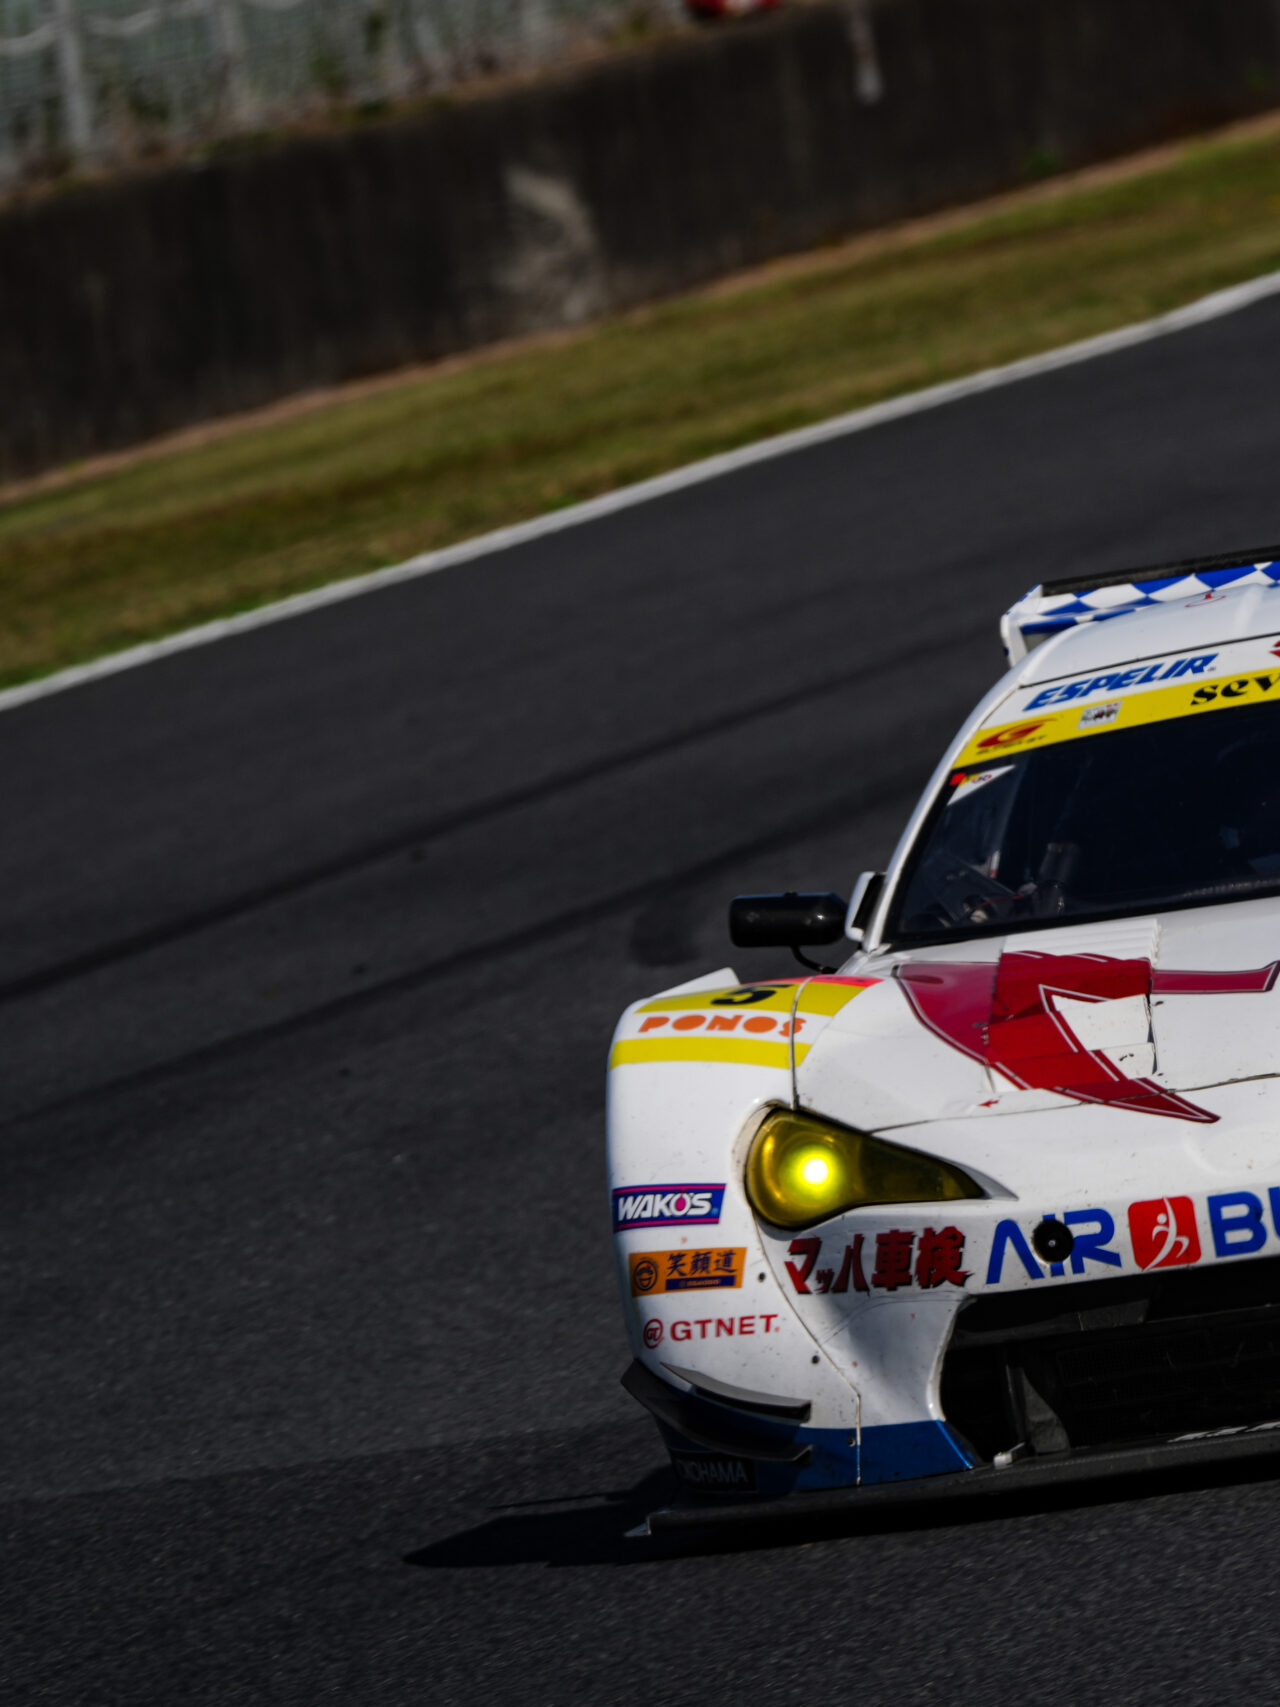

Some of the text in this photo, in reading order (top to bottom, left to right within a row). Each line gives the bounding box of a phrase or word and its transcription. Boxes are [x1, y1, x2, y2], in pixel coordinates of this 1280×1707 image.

[1023, 653, 1218, 712] ESPELIR
[637, 1014, 807, 1037] PONOS
[666, 1249, 738, 1277] 笑顔道
[783, 1225, 975, 1296] マッハ車検
[985, 1208, 1123, 1285] AR
[669, 1313, 779, 1342] GTNET
